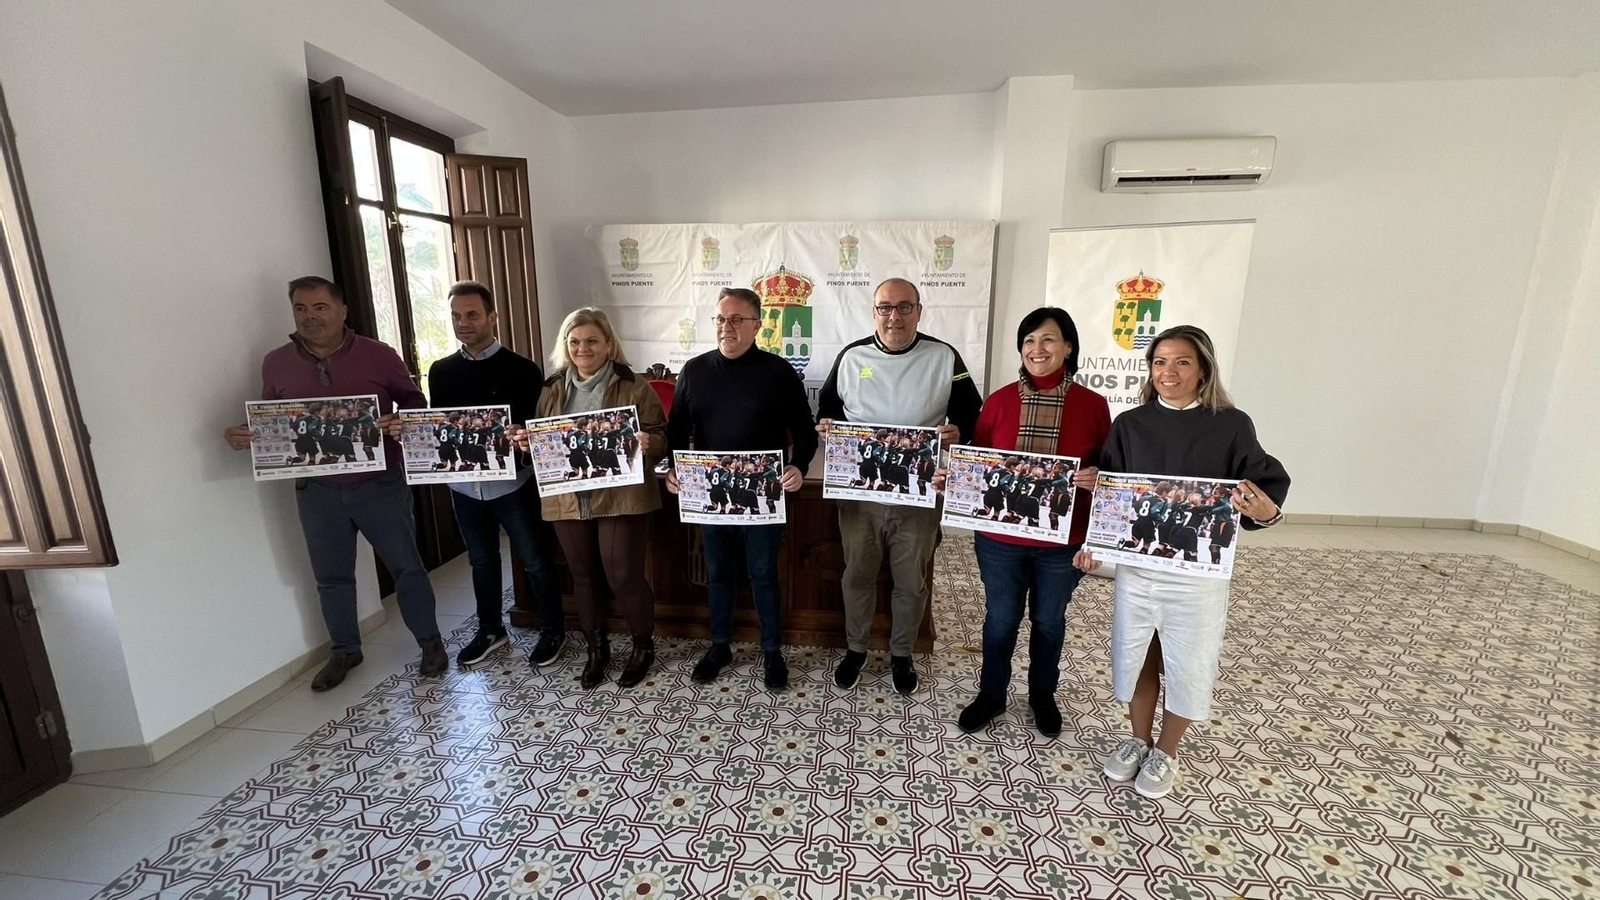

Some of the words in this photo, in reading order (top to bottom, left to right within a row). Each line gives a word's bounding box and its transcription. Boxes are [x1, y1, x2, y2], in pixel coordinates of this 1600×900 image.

[1078, 357, 1148, 372] UNTAMIE
[1075, 374, 1118, 389] NOS
[298, 420, 307, 434] 8
[336, 424, 344, 436] 7
[440, 429, 448, 442] 8
[472, 433, 479, 445] 7
[569, 435, 578, 449] 8
[601, 437, 609, 450] 7
[863, 445, 872, 459] 8
[897, 453, 904, 466] 7
[711, 472, 719, 485] 8
[743, 478, 751, 490] 7
[989, 472, 1000, 487] 8
[1027, 483, 1036, 496] 7
[1139, 500, 1150, 517] 8
[1182, 511, 1193, 527] 7
